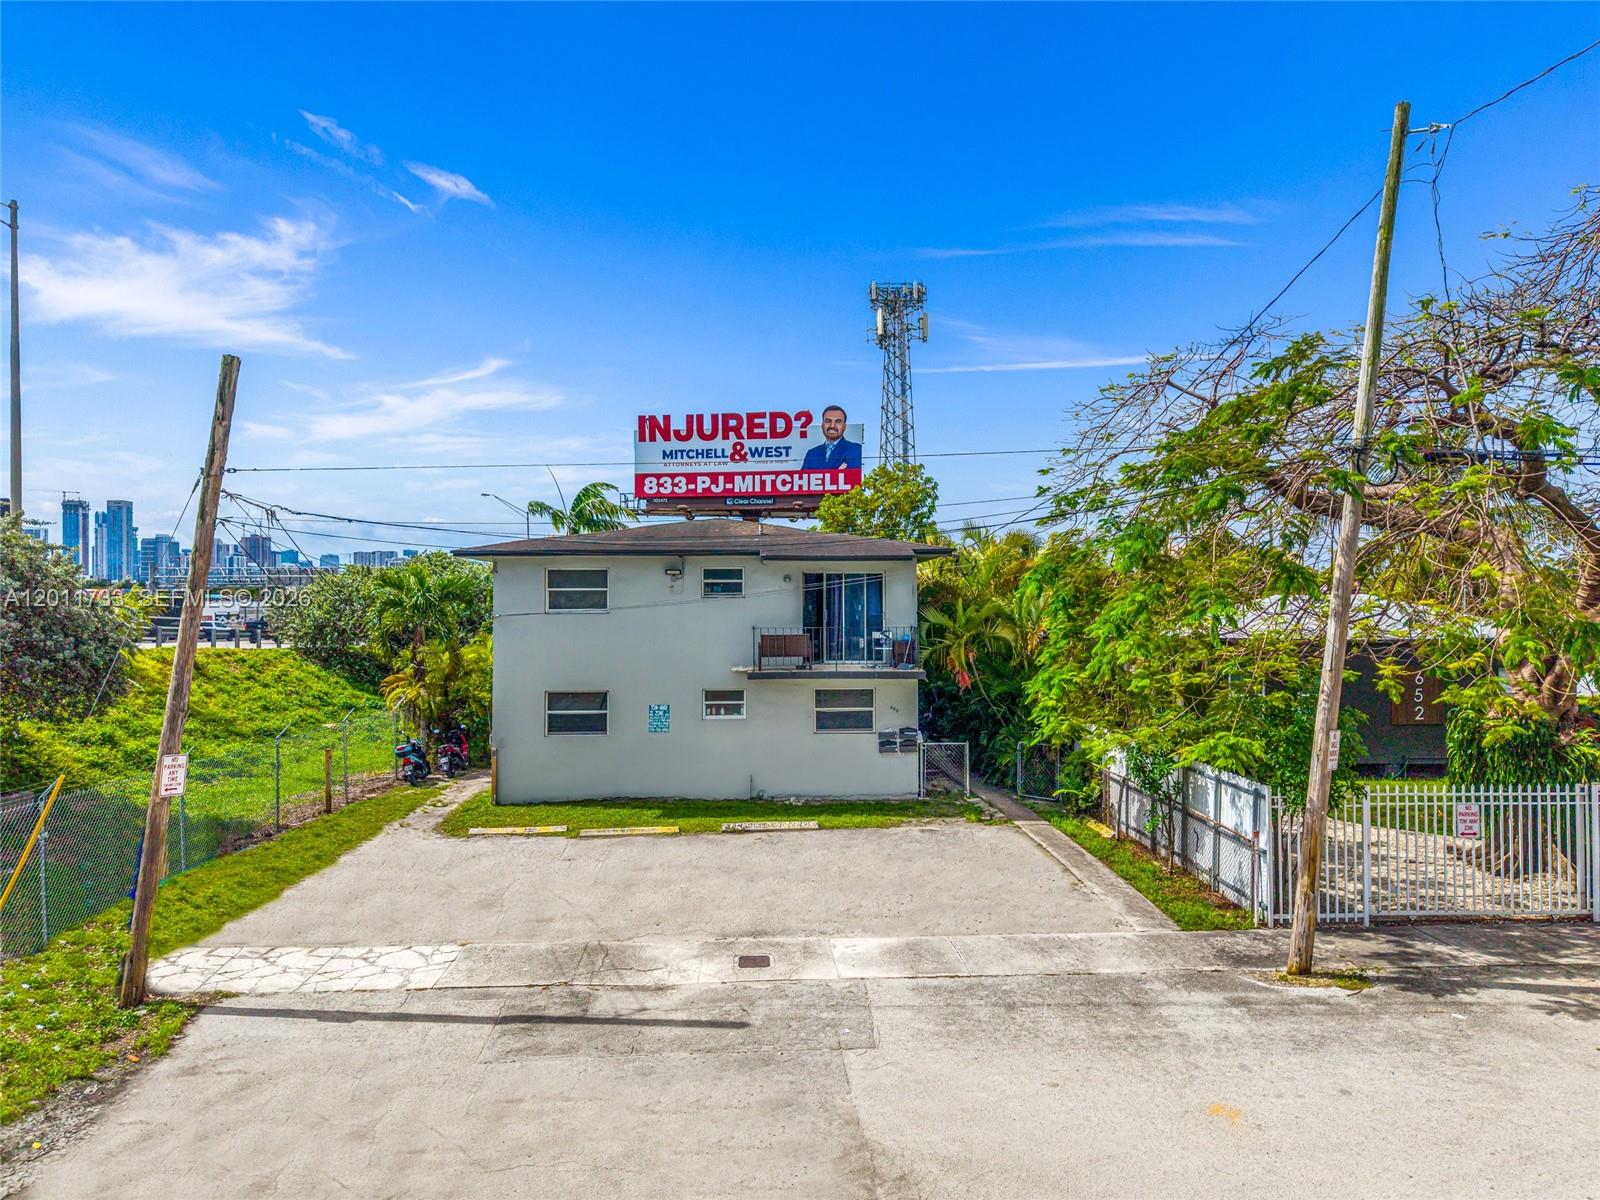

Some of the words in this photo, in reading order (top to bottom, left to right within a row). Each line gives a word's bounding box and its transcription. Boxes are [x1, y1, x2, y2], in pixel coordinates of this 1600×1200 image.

[637, 410, 813, 442] INJURED?
[662, 449, 729, 460] MITCHELL
[729, 442, 749, 464] &
[748, 446, 792, 458] WEST
[643, 473, 851, 495] 833-PJ-MITCHELL
[1414, 671, 1424, 720] 652
